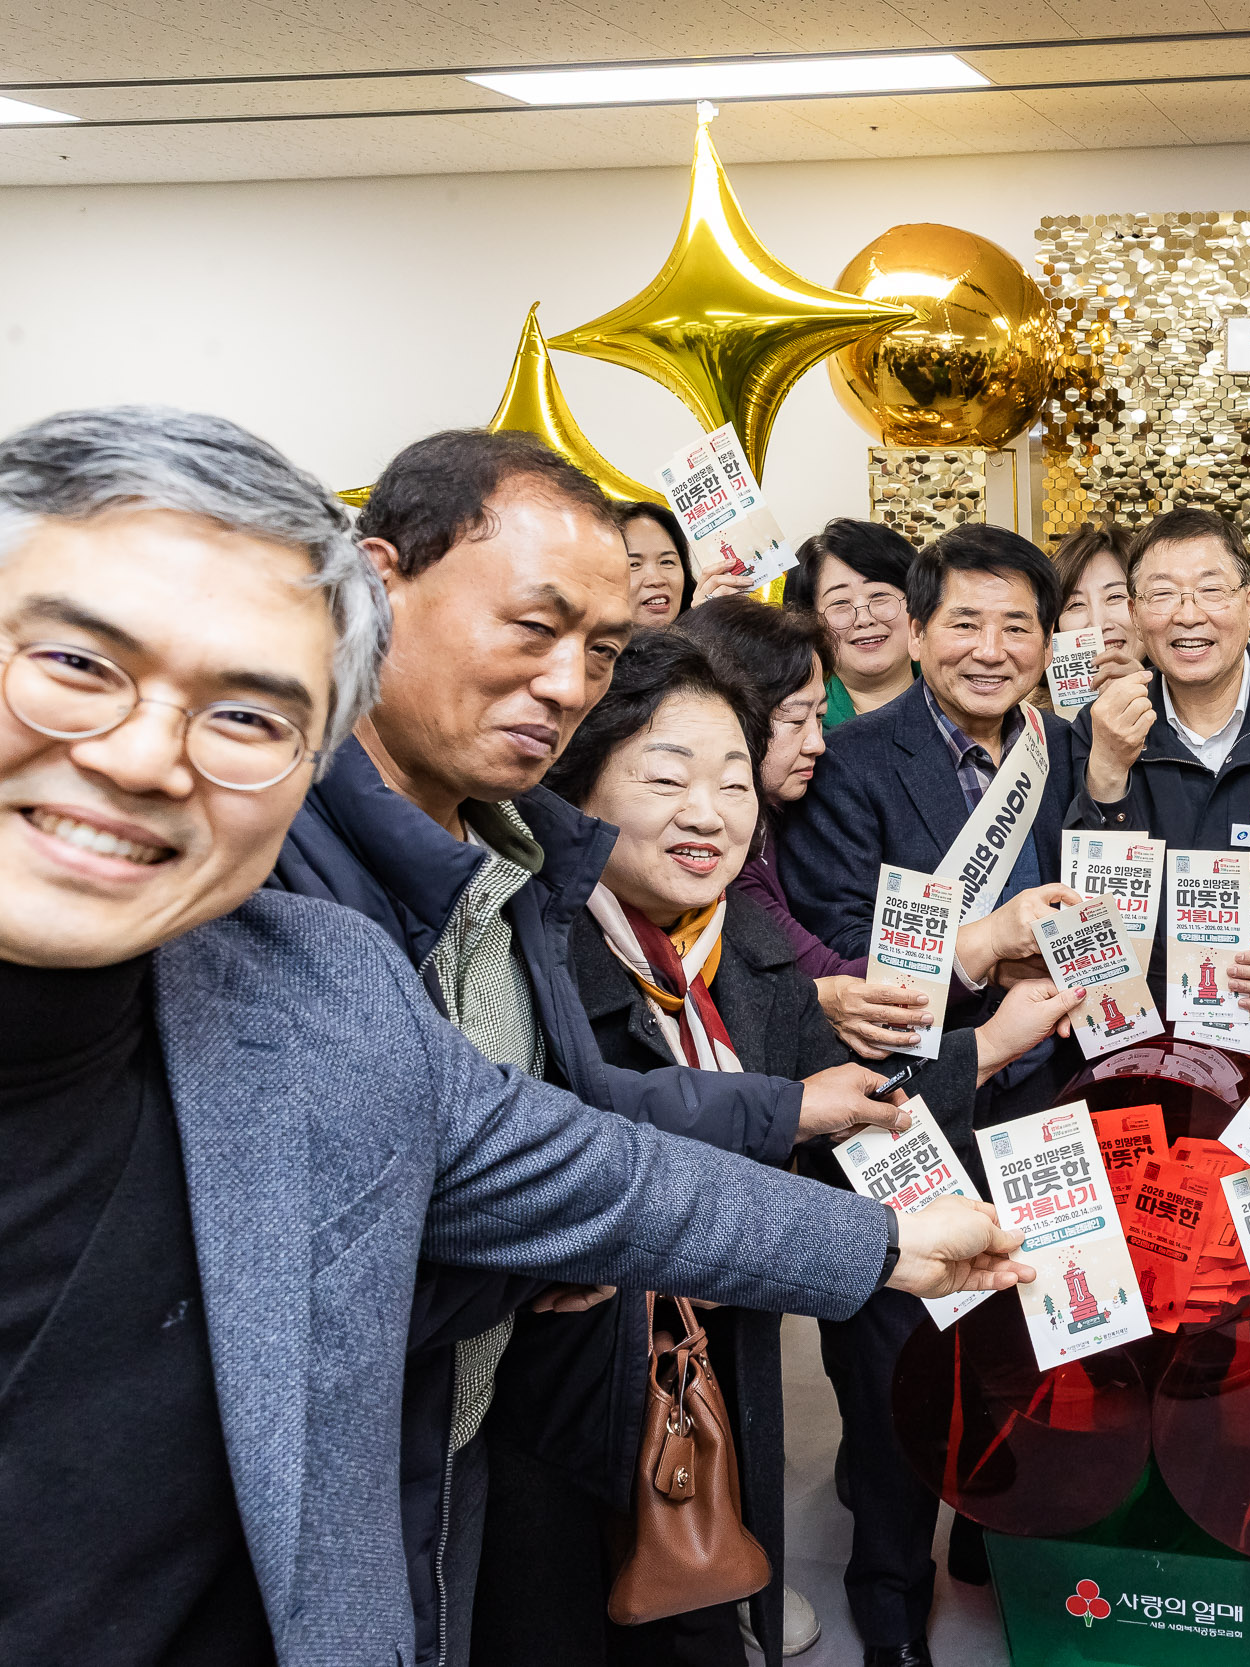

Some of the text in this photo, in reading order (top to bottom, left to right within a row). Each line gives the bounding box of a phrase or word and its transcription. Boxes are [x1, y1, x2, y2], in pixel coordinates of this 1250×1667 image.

[671, 478, 688, 497] 2026
[676, 474, 722, 512] 따뜻한
[684, 489, 728, 525] 겨울나기
[1052, 655, 1069, 664] 2026
[1056, 676, 1095, 691] 겨울나
[1088, 865, 1152, 878] 2026 희망온돌
[1177, 879, 1240, 890] 2026 희망온돌
[1085, 876, 1151, 897] 따뜻한
[1176, 890, 1240, 909] 따뜻한
[886, 897, 949, 918] 2026 희망온돌
[1177, 909, 1239, 924] 겨울나기
[882, 908, 948, 938] 따뜻한
[1050, 935, 1074, 949] 2026
[1075, 919, 1112, 939] 희망온돌
[880, 928, 943, 954] 겨울나기
[1053, 929, 1118, 964] 따뜻한
[1060, 945, 1123, 976] 겨울나기
[861, 1131, 931, 1181] 2026 희망온돌
[1000, 1142, 1085, 1176] 2026 희망온돌
[868, 1143, 942, 1201] 따뜻한
[1003, 1157, 1091, 1204] 따뜻한
[1011, 1183, 1097, 1224] 겨울나기
[1141, 1184, 1164, 1198] 2026
[1167, 1191, 1204, 1211] 희망온돌
[1136, 1194, 1200, 1230] 따뜻한
[1149, 1621, 1243, 1638] 서울 사회복지공동모금회
